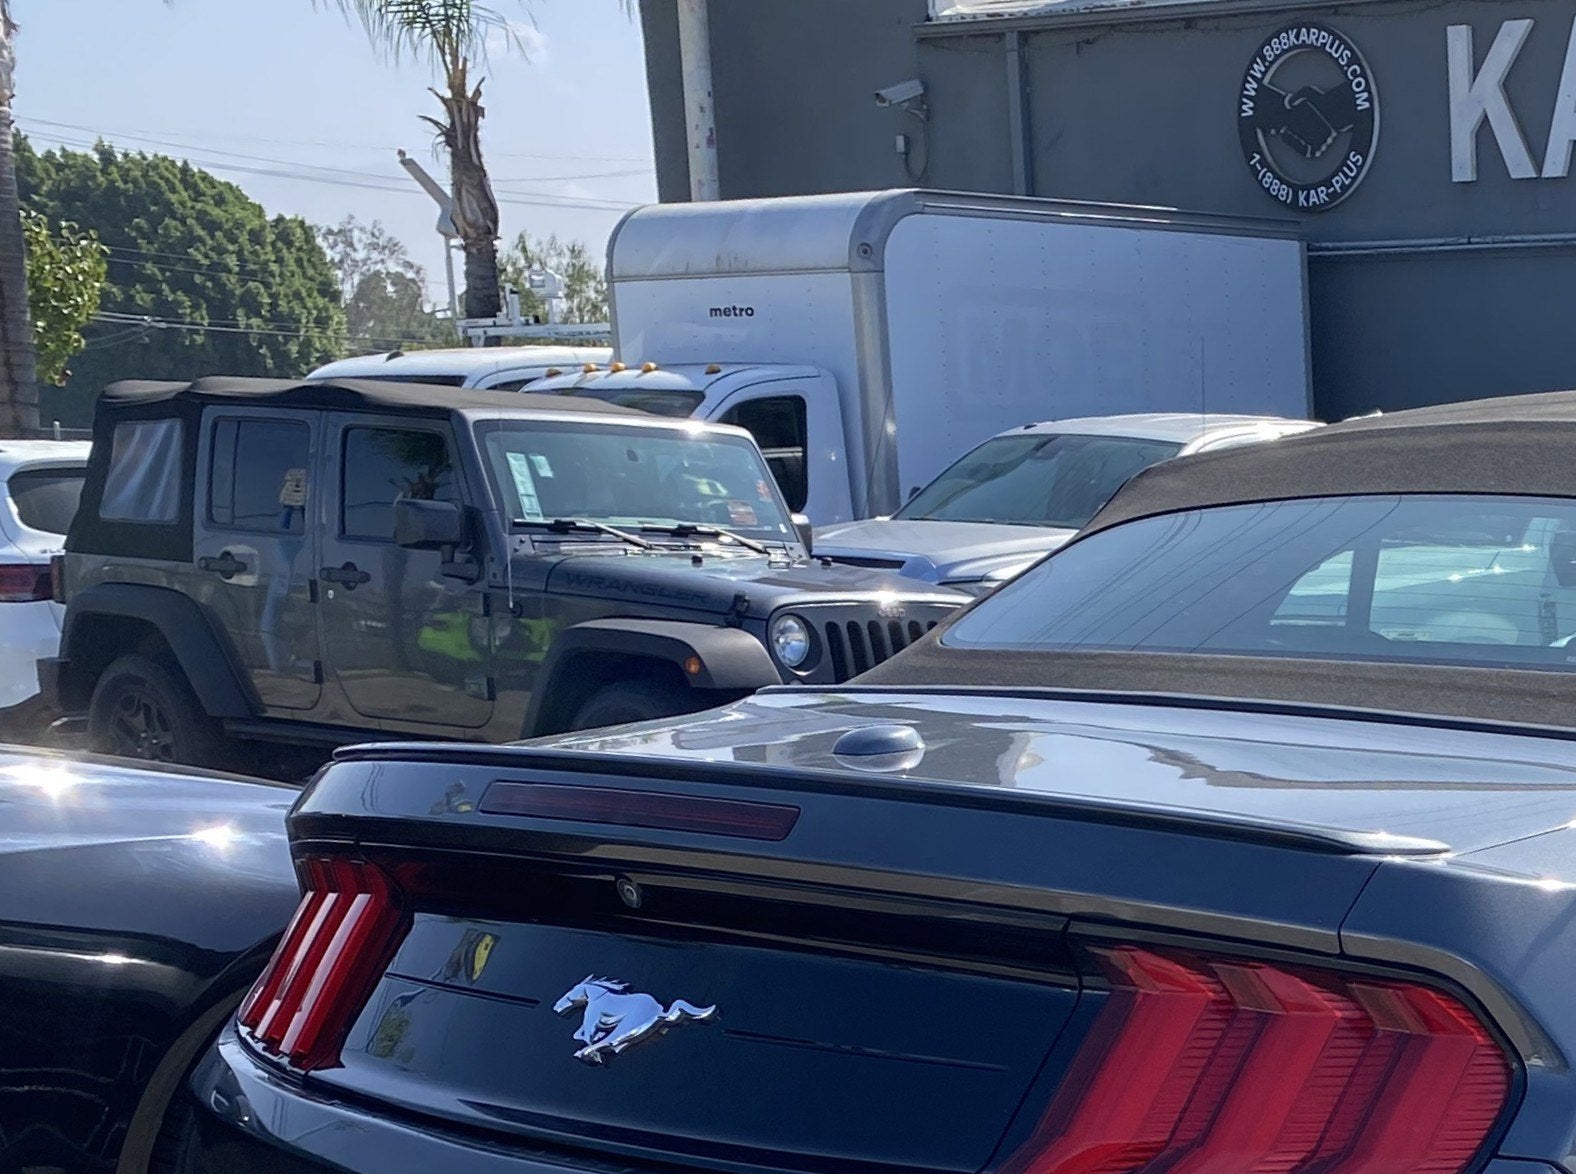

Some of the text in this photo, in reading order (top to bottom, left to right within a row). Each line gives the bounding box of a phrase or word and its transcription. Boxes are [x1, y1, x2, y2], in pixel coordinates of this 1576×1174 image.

[1240, 27, 1371, 118] WWW.888KARPLUS.COM
[1249, 150, 1363, 207] 1-(888) KAR-PLUS
[708, 304, 756, 318] metro
